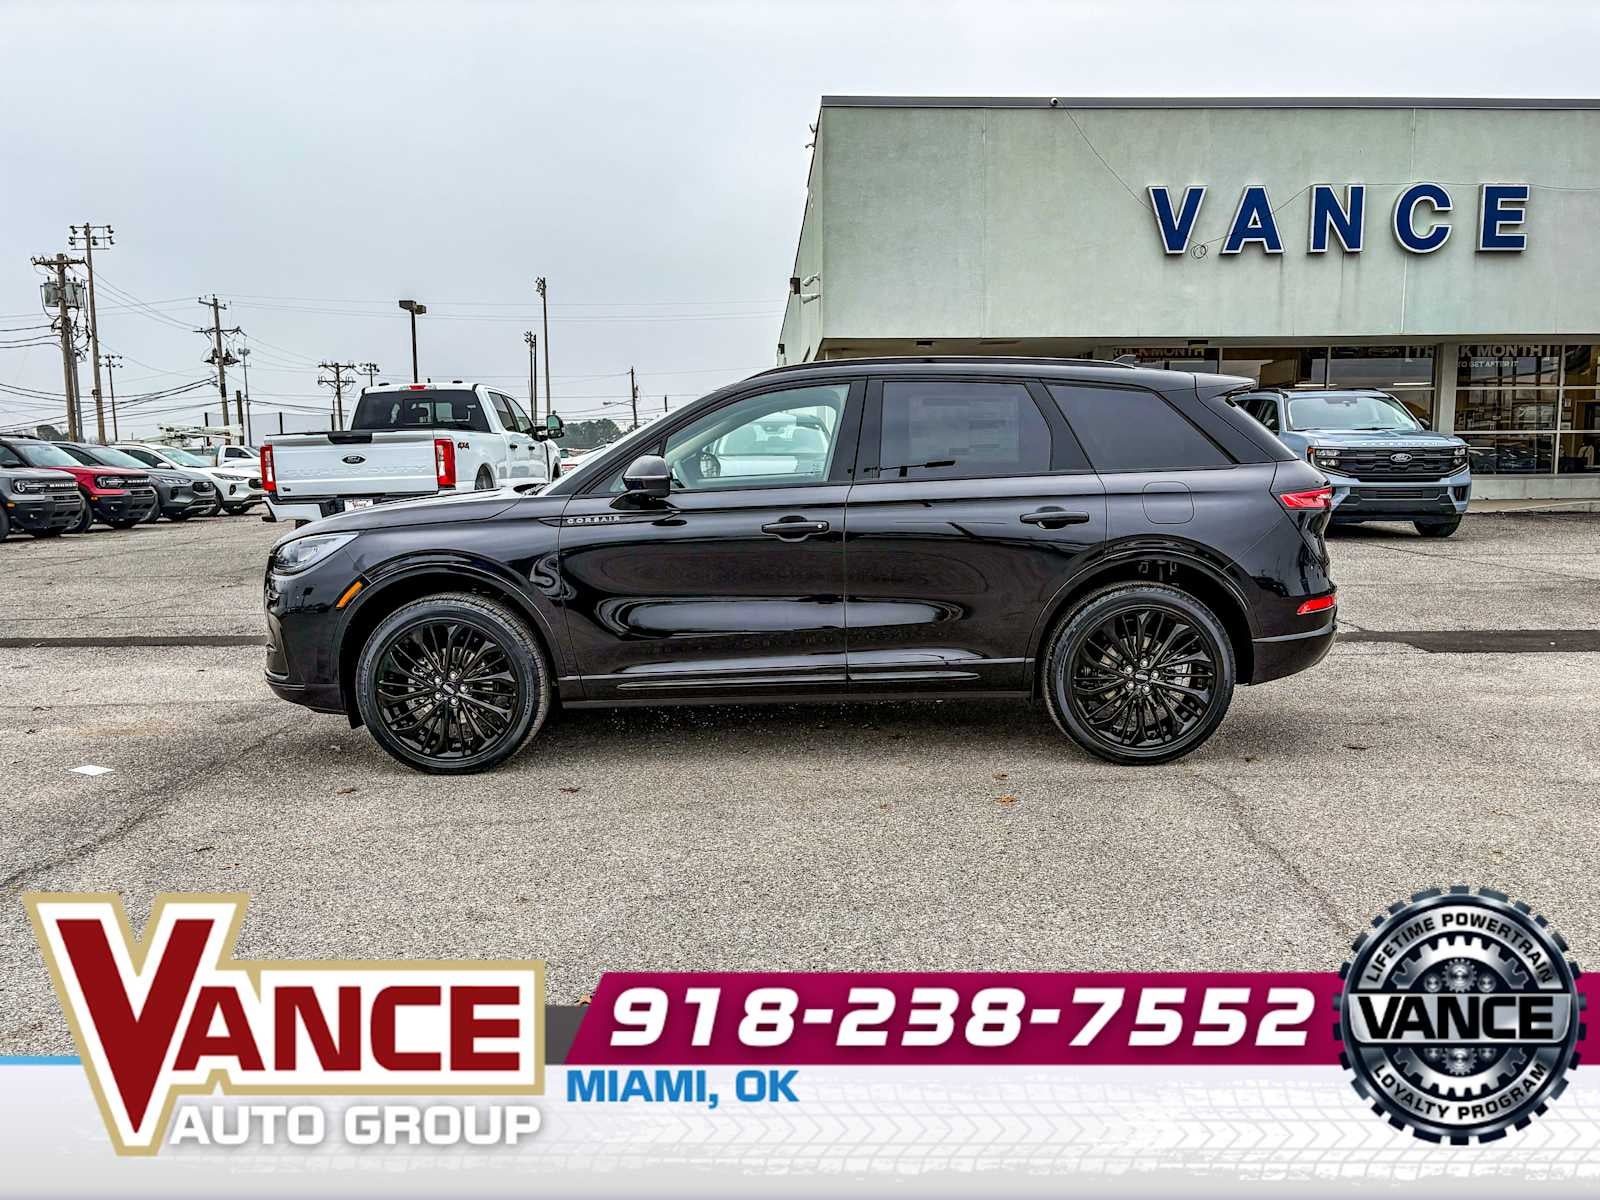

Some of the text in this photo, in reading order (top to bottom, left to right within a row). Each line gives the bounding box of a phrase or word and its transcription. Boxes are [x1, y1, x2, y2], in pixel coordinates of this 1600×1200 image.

[1147, 182, 1531, 255] VANCE
[1476, 344, 1542, 357] MONTH
[566, 515, 620, 524] CORSAIR
